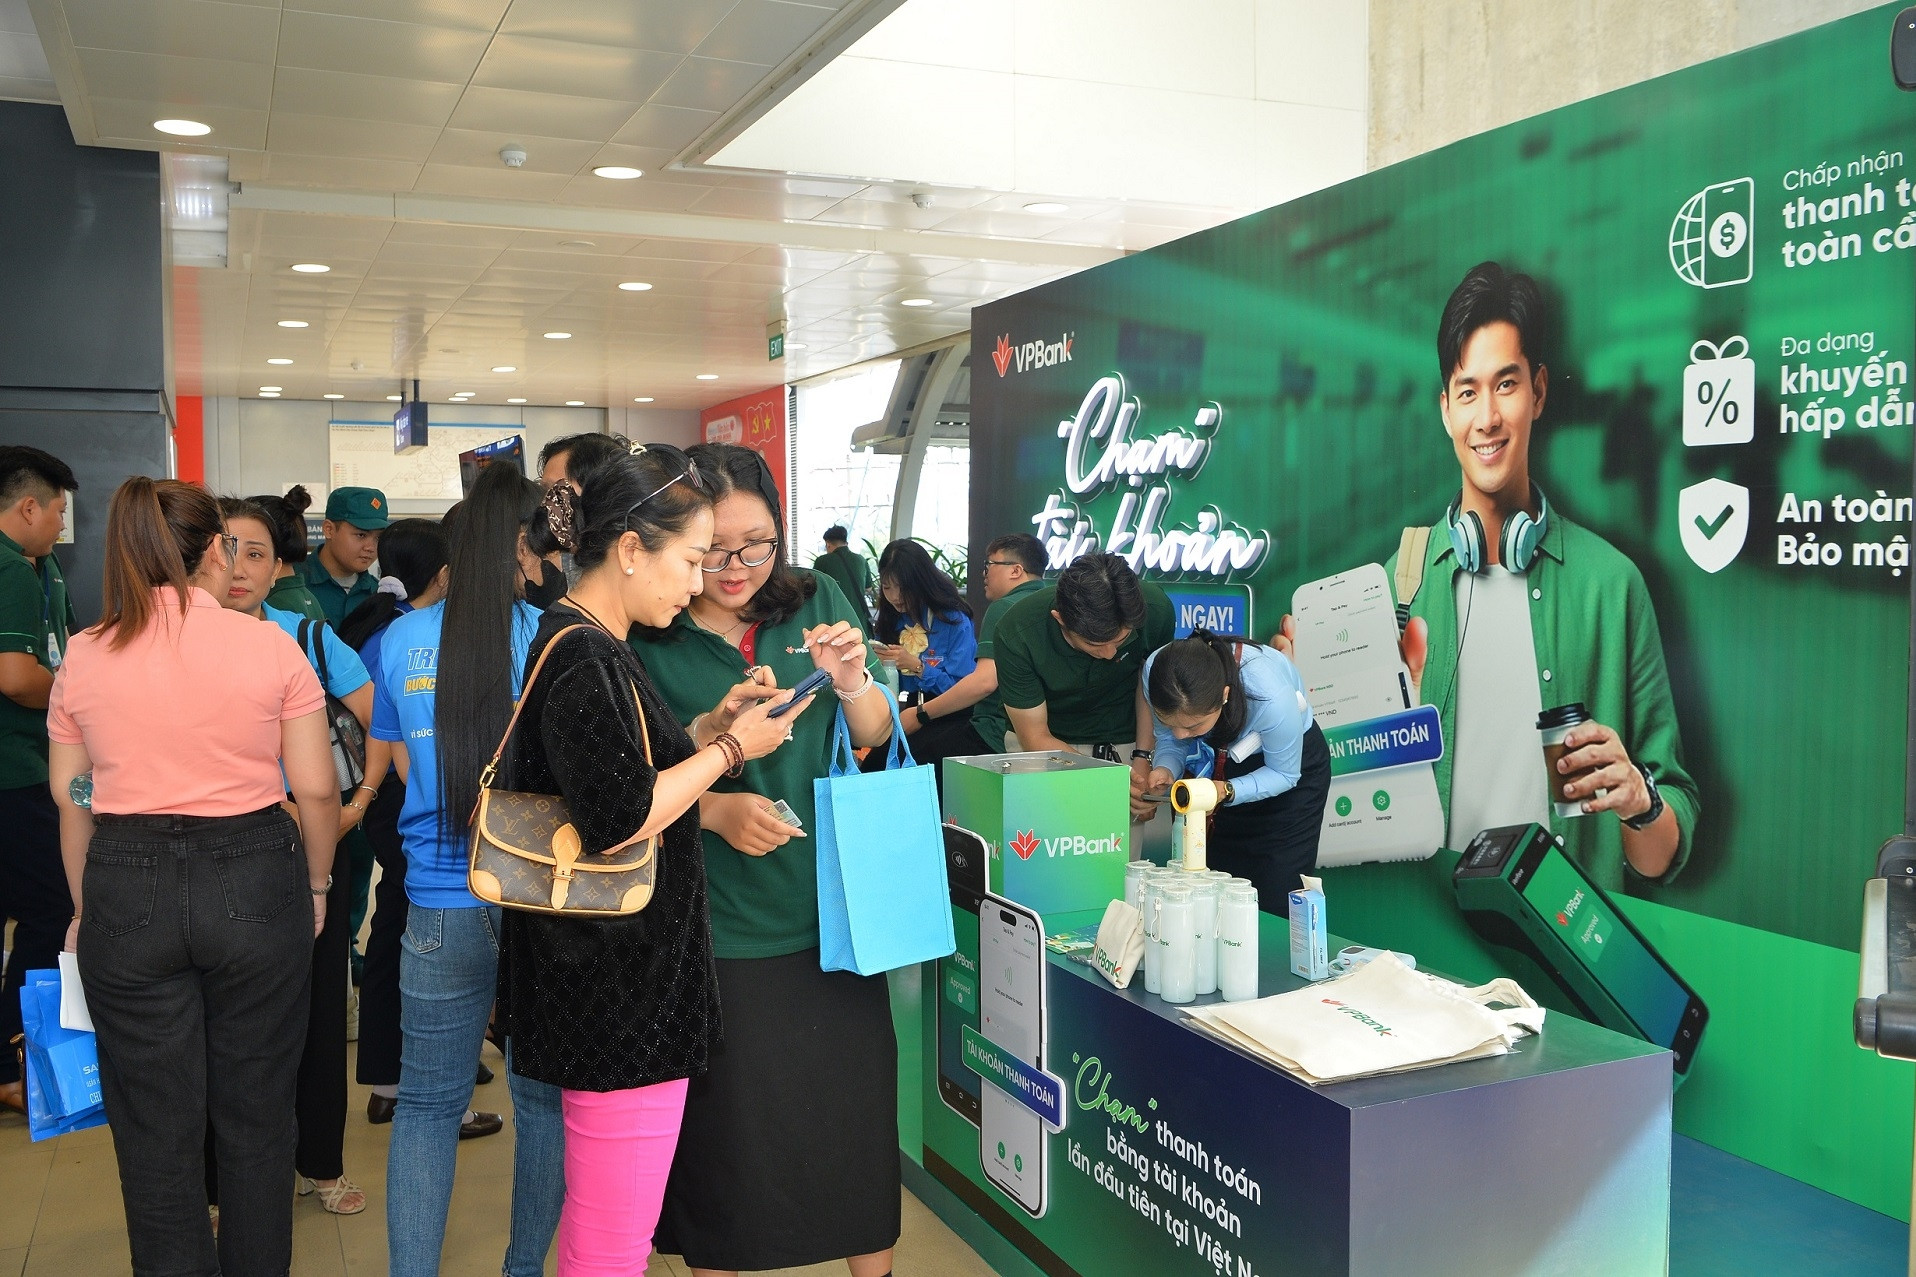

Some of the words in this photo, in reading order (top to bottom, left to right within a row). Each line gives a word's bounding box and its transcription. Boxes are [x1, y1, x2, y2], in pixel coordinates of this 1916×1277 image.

[1782, 161, 1842, 191] Chấp
[1847, 150, 1904, 176] nhận
[1782, 182, 1885, 229] thanh
[1896, 178, 1916, 207] t
[1782, 230, 1862, 268] toàn
[1015, 336, 1074, 374] VPBank
[1781, 337, 1811, 357] Đa
[1817, 331, 1875, 356] dạng
[1780, 350, 1907, 398] khuyến
[1780, 397, 1846, 439] hấp
[1776, 493, 1822, 523] An
[1832, 490, 1913, 523] toàn
[1105, 487, 1265, 575] khoản
[1777, 532, 1843, 566] Bảo
[1181, 604, 1234, 633] NGAY!
[1346, 731, 1390, 756] THANH
[1390, 722, 1430, 748] TOÁN
[1044, 833, 1122, 858] VPBank
[1563, 889, 1585, 918] VPBank
[1337, 1006, 1392, 1036] VPBank
[83, 1063, 99, 1075] SA
[966, 1039, 978, 1058] TÀI
[1004, 1065, 1030, 1093] THANH
[1031, 1082, 1054, 1109] TOÁN
[1156, 1120, 1209, 1173] thanh
[1214, 1155, 1261, 1206] toán
[1107, 1127, 1149, 1182] bằng
[1153, 1160, 1177, 1195] tài
[1182, 1175, 1242, 1239] khoản
[1068, 1138, 1090, 1176] lần
[1094, 1161, 1124, 1200] đầu
[1128, 1184, 1161, 1226] tiên
[1165, 1209, 1189, 1247] tại
[1194, 1224, 1232, 1276] Việt
[1238, 1255, 1260, 1277] N
